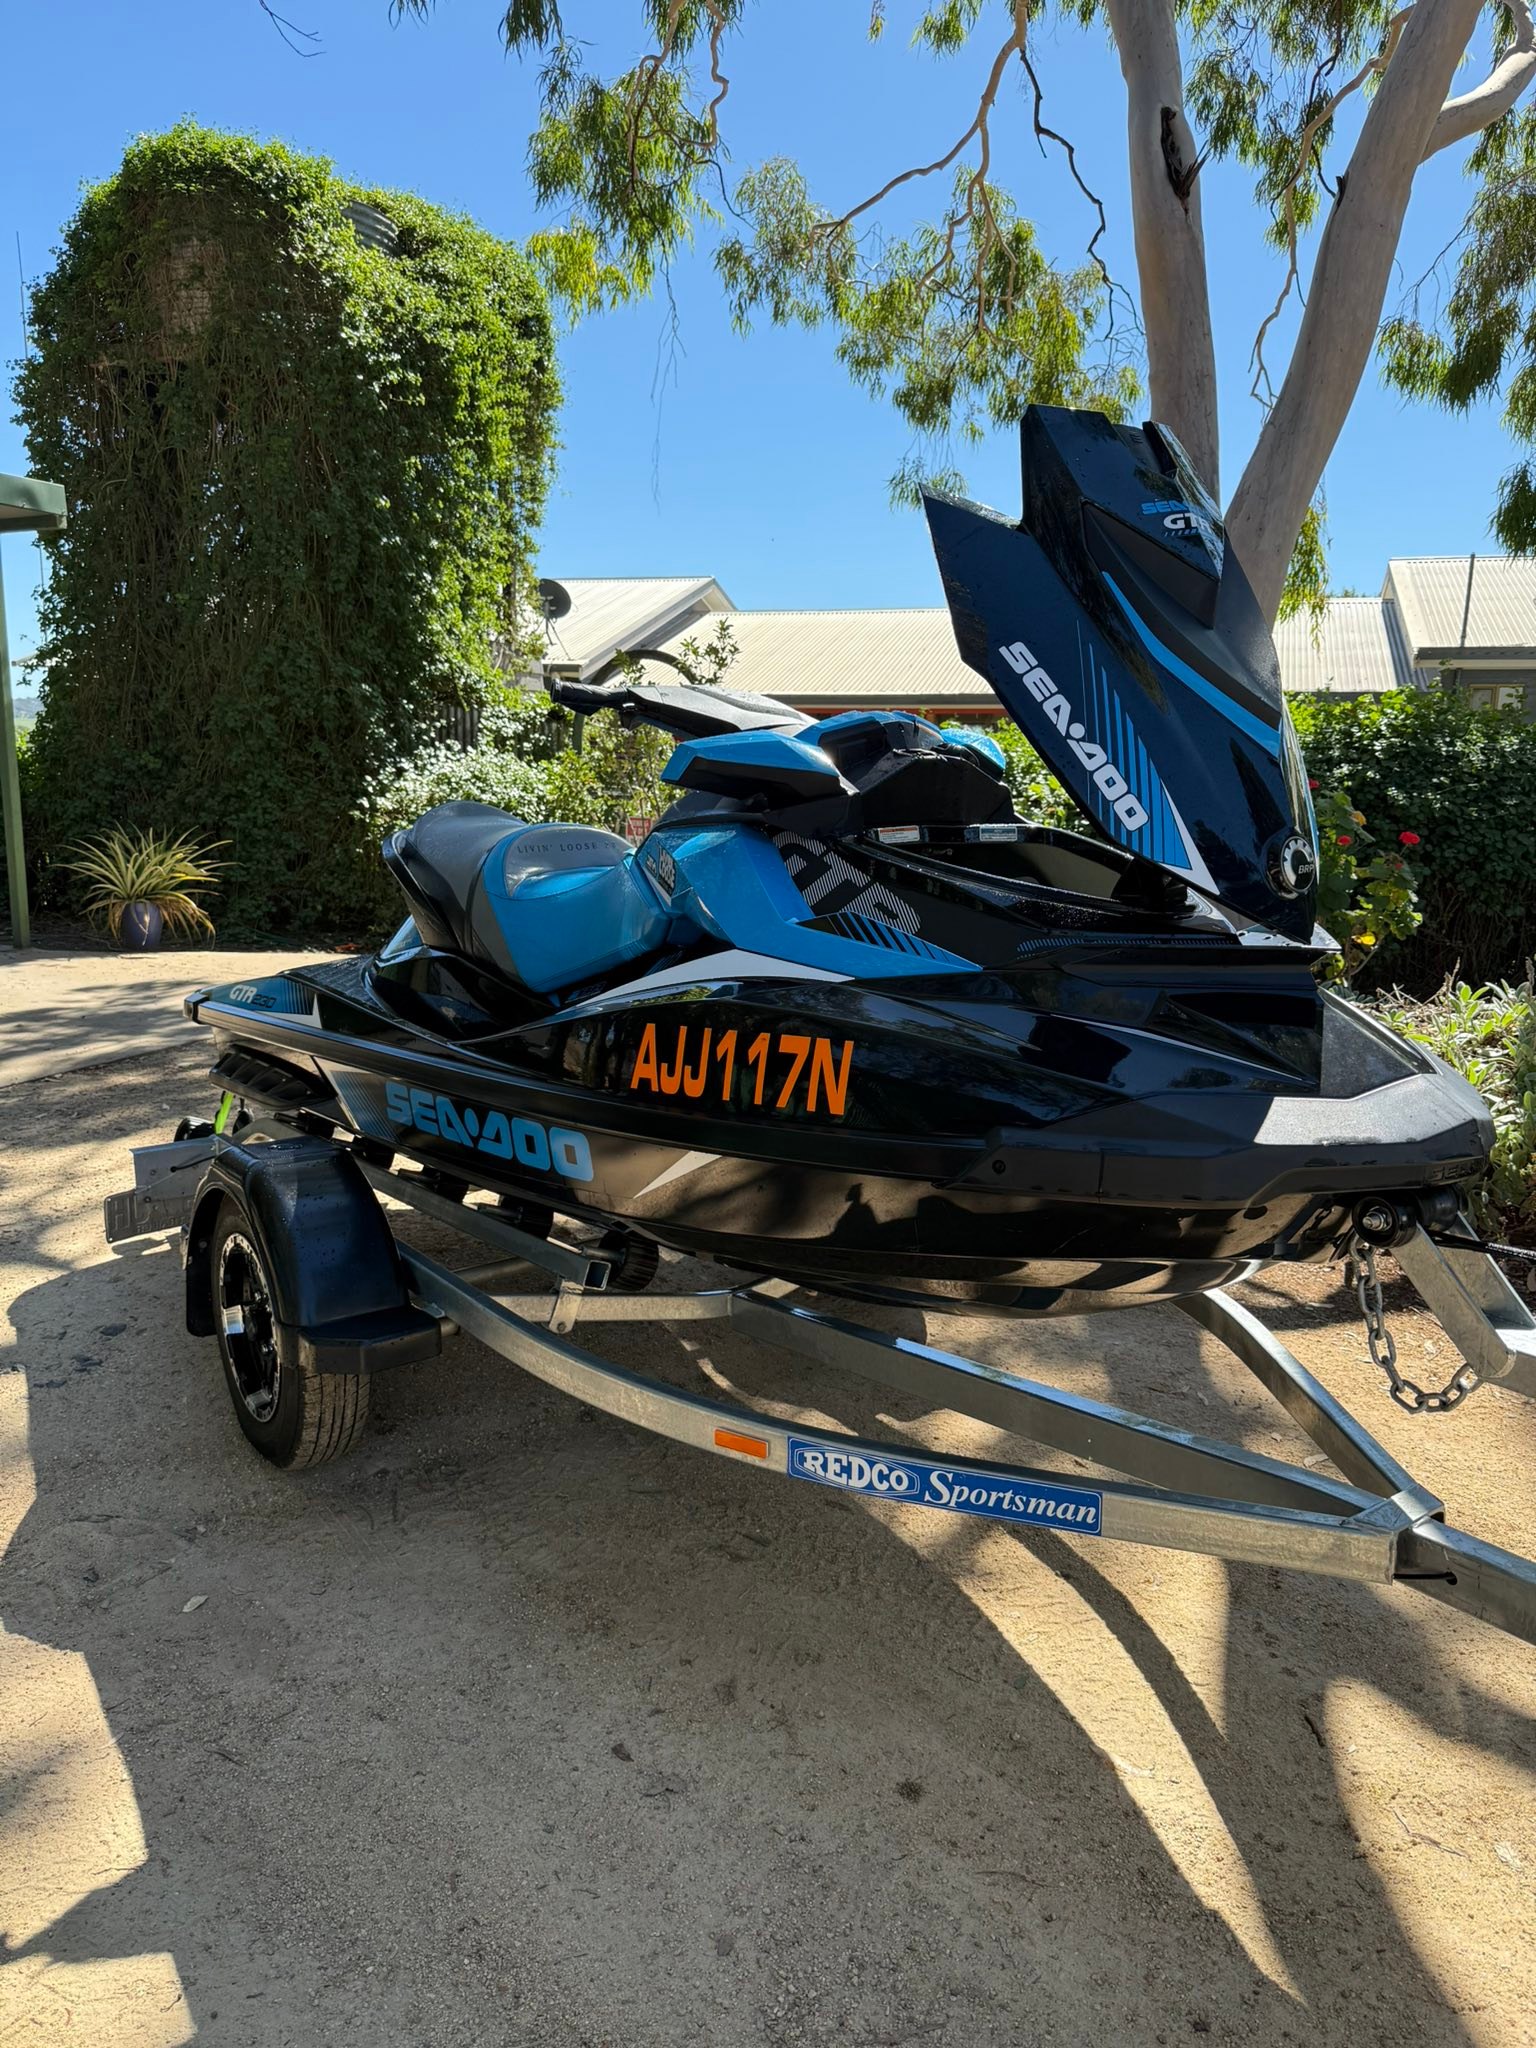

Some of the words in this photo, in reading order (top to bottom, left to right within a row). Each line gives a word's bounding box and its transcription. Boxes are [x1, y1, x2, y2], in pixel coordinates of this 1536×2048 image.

[560, 841, 598, 853] LOOSE
[1298, 864, 1314, 874] BRP
[229, 984, 257, 1004] GTR
[630, 1022, 854, 1115] AJJ117N
[924, 1470, 1097, 1524] Sportsman
